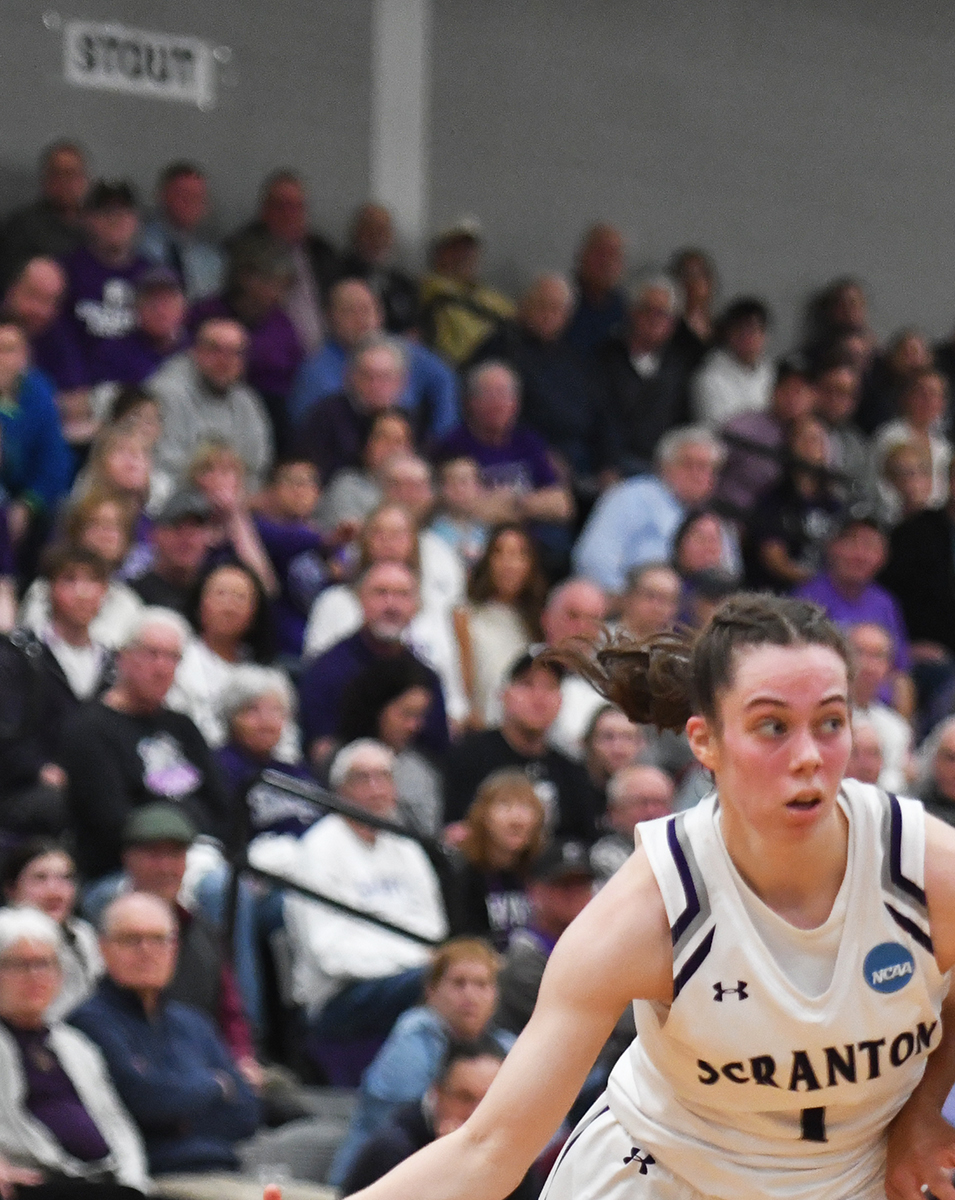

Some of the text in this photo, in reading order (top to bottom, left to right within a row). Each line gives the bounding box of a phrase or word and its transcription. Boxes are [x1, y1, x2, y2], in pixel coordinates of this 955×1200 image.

[82, 35, 193, 85] STOUT
[872, 961, 914, 985] NCAA
[696, 1020, 938, 1092] SCRANTON
[799, 1105, 829, 1144] 1
